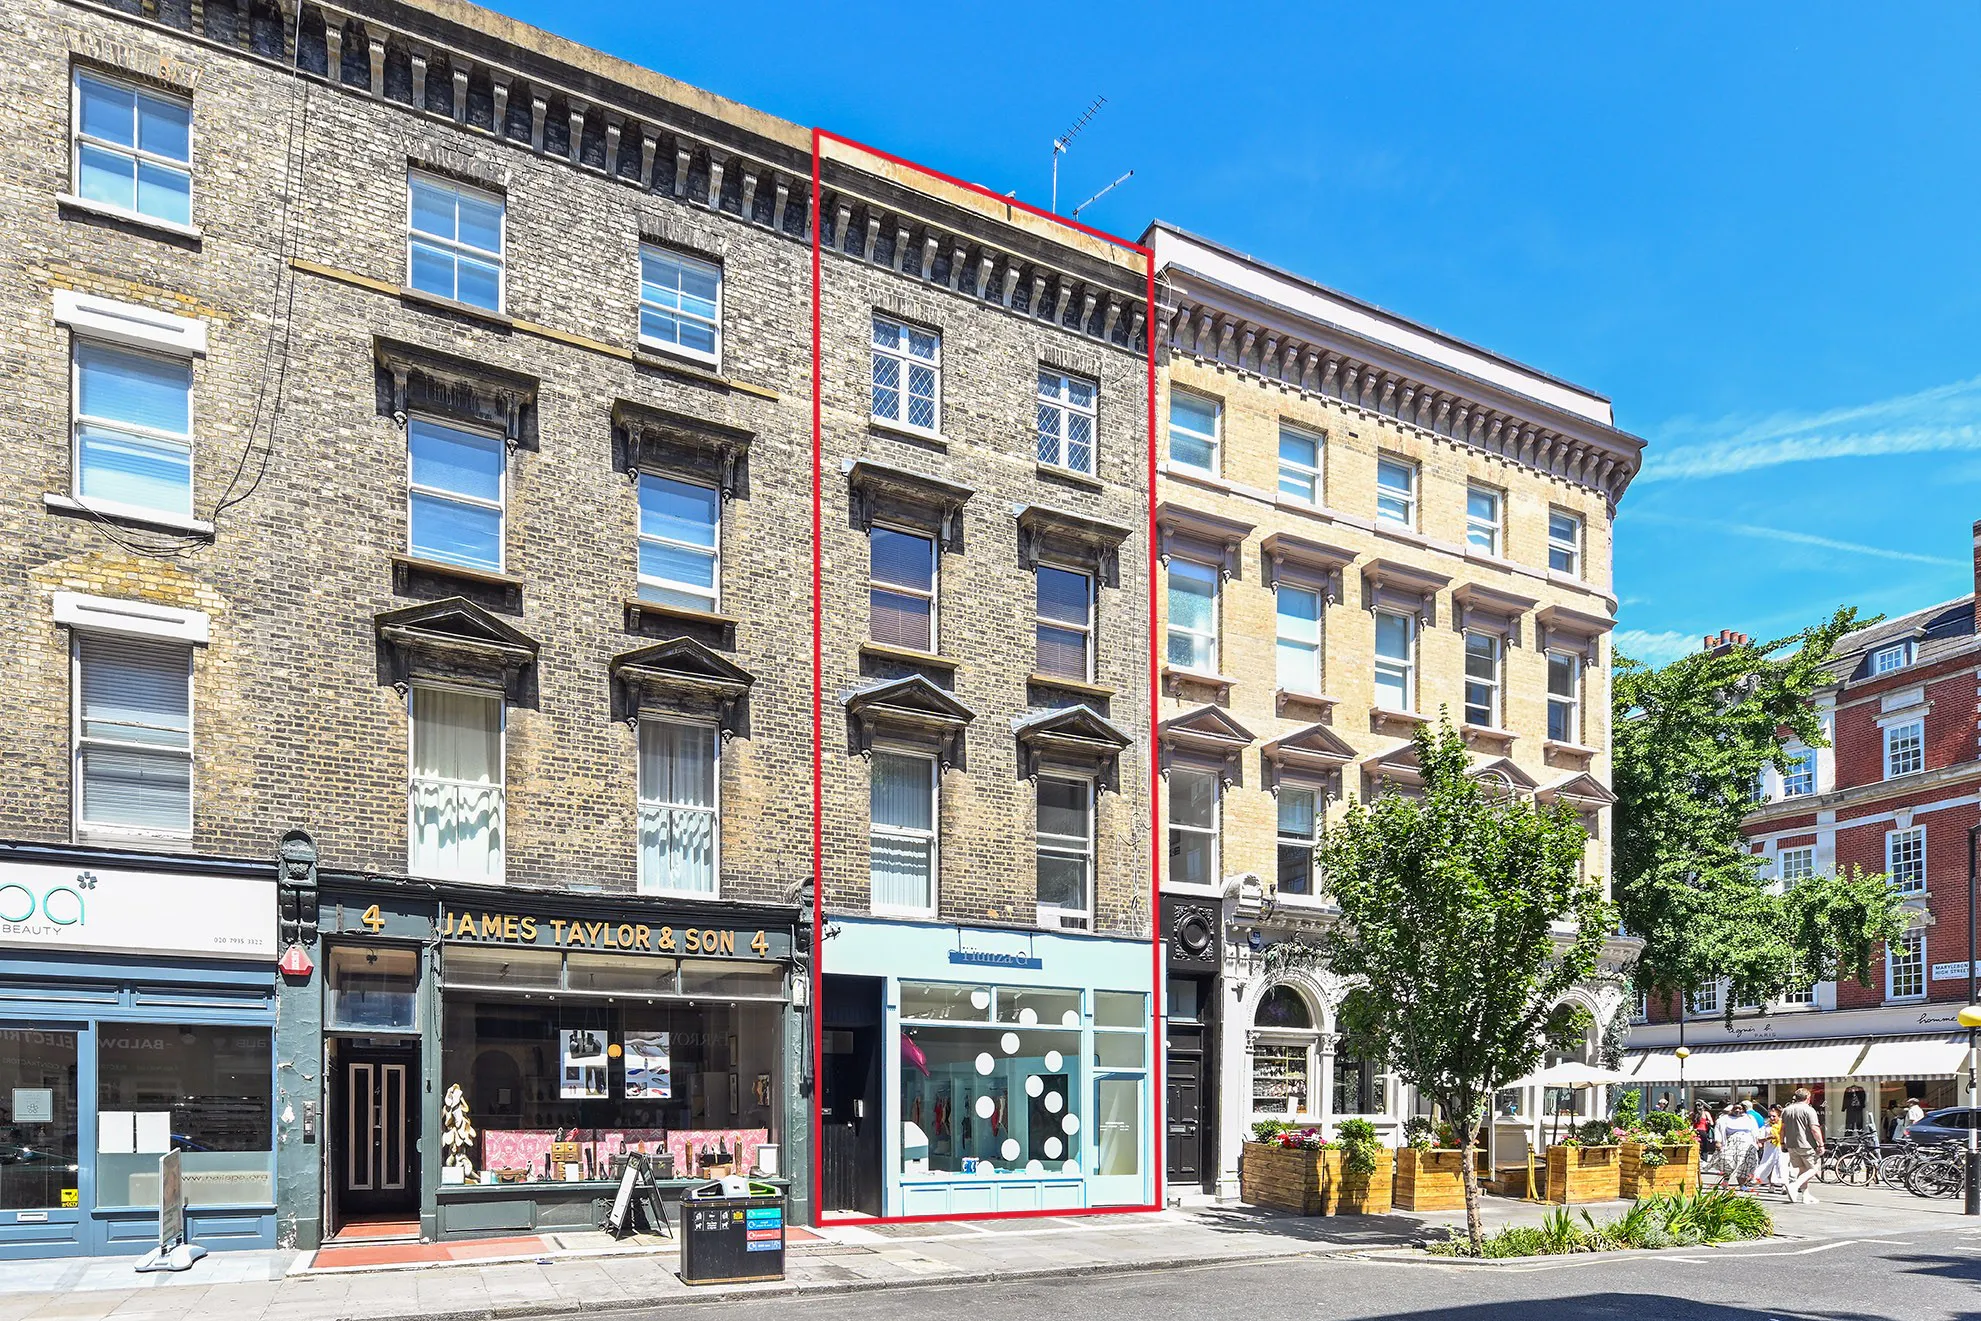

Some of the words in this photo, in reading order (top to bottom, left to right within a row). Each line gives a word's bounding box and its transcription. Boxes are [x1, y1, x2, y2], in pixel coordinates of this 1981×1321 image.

[2, 924, 62, 936] BEAUTY
[361, 904, 385, 935] 4
[444, 911, 538, 943] JAMES
[550, 919, 650, 950] TAYLOR
[658, 925, 677, 952] &
[685, 927, 735, 956] SON
[750, 930, 770, 958] 4
